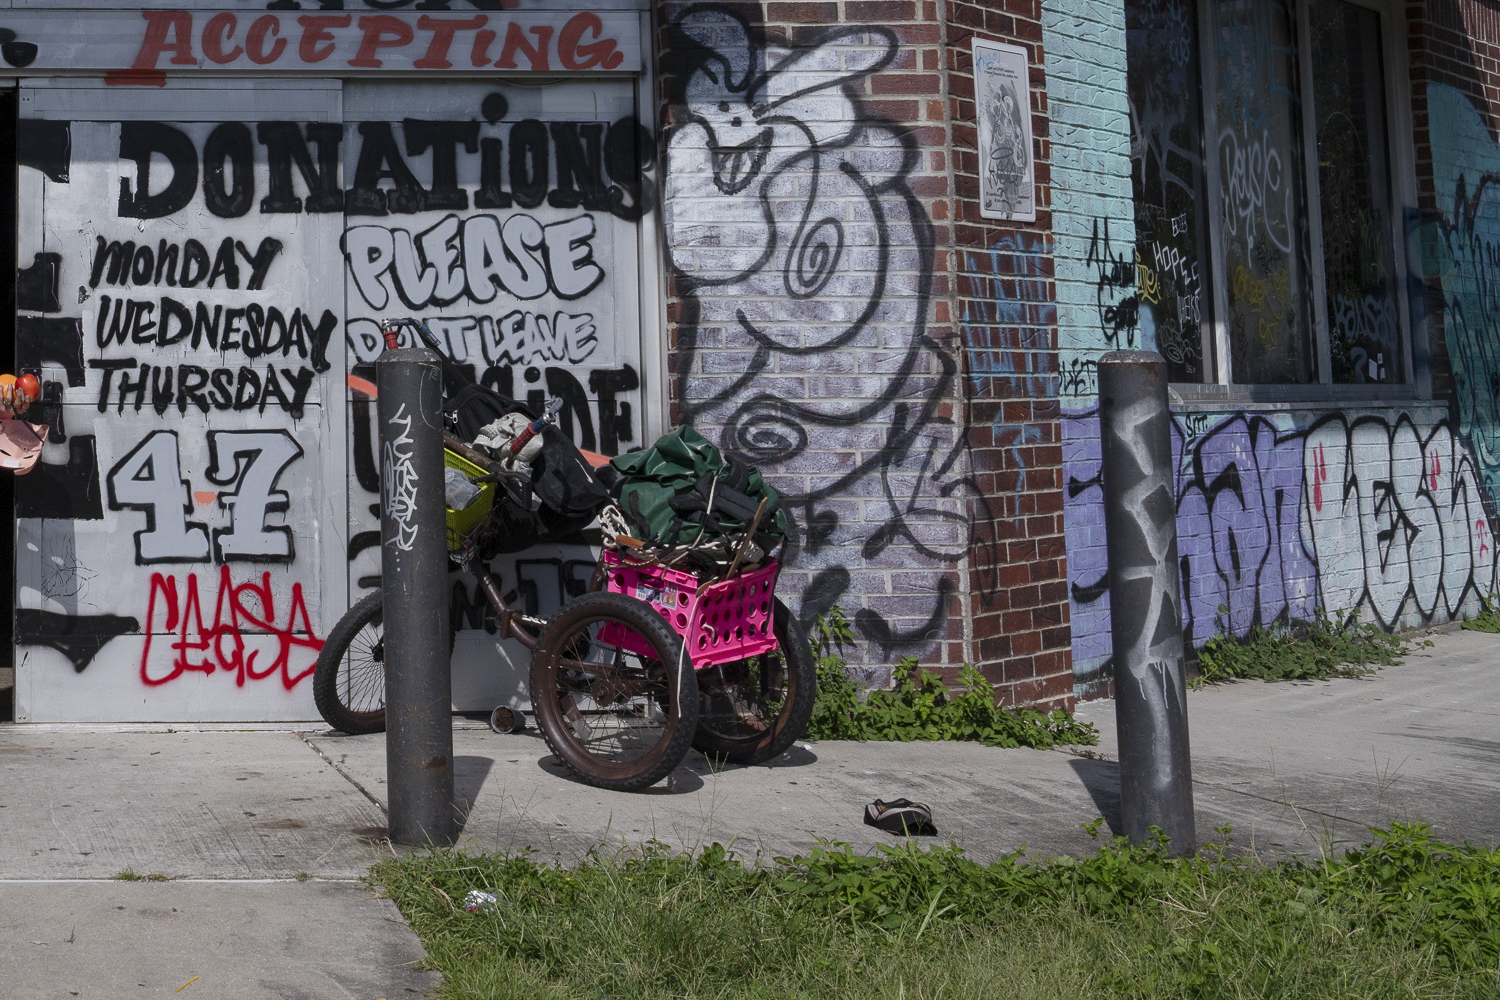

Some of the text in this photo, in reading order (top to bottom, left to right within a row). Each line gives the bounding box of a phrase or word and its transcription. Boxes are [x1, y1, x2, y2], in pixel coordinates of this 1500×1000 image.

[340, 213, 605, 312] PLEASE
[97, 294, 338, 373] WEDNESDAY
[478, 310, 598, 365] LEAVE
[88, 358, 315, 419] THURSDAY
